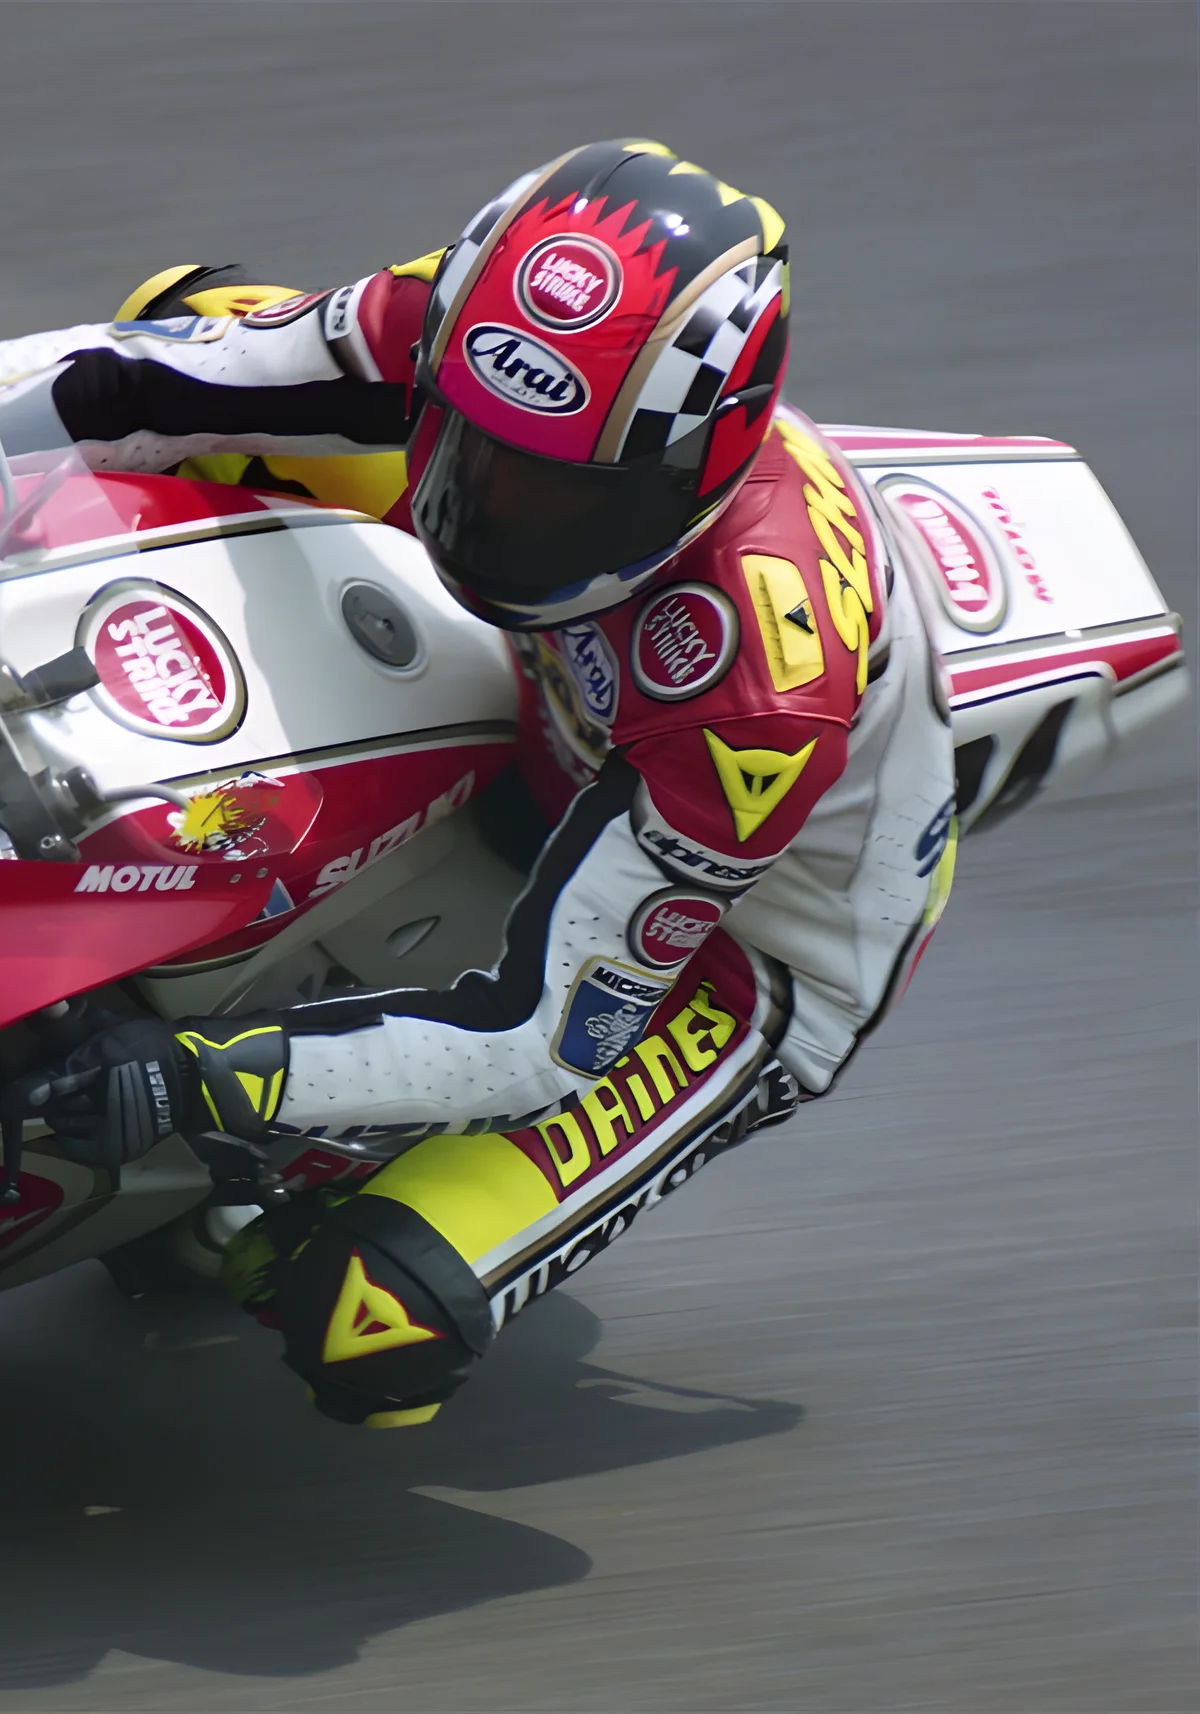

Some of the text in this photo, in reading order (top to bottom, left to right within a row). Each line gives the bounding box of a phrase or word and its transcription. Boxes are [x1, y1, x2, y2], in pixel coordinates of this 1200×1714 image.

[472, 339, 575, 402] Arai
[107, 619, 189, 727] STRIKE
[134, 605, 222, 713] LUCKY
[74, 865, 198, 893] MOTUL
[308, 769, 476, 897] SUZ
